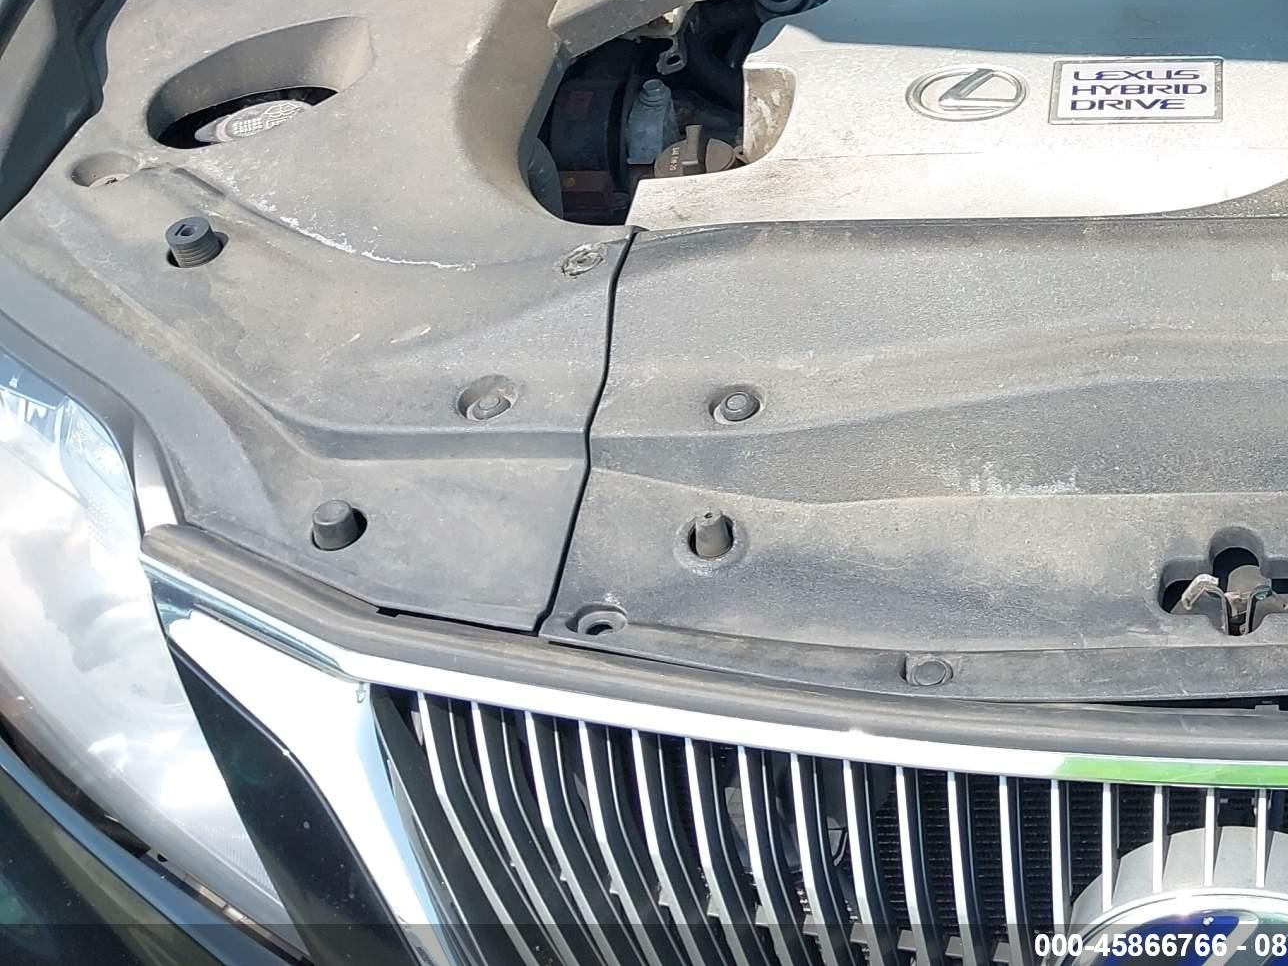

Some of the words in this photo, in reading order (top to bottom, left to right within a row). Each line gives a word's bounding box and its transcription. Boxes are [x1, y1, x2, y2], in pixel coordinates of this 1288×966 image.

[1073, 69, 1201, 81] LEXUS
[1071, 83, 1208, 96] HYBRID
[1070, 98, 1186, 111] DRIVE
